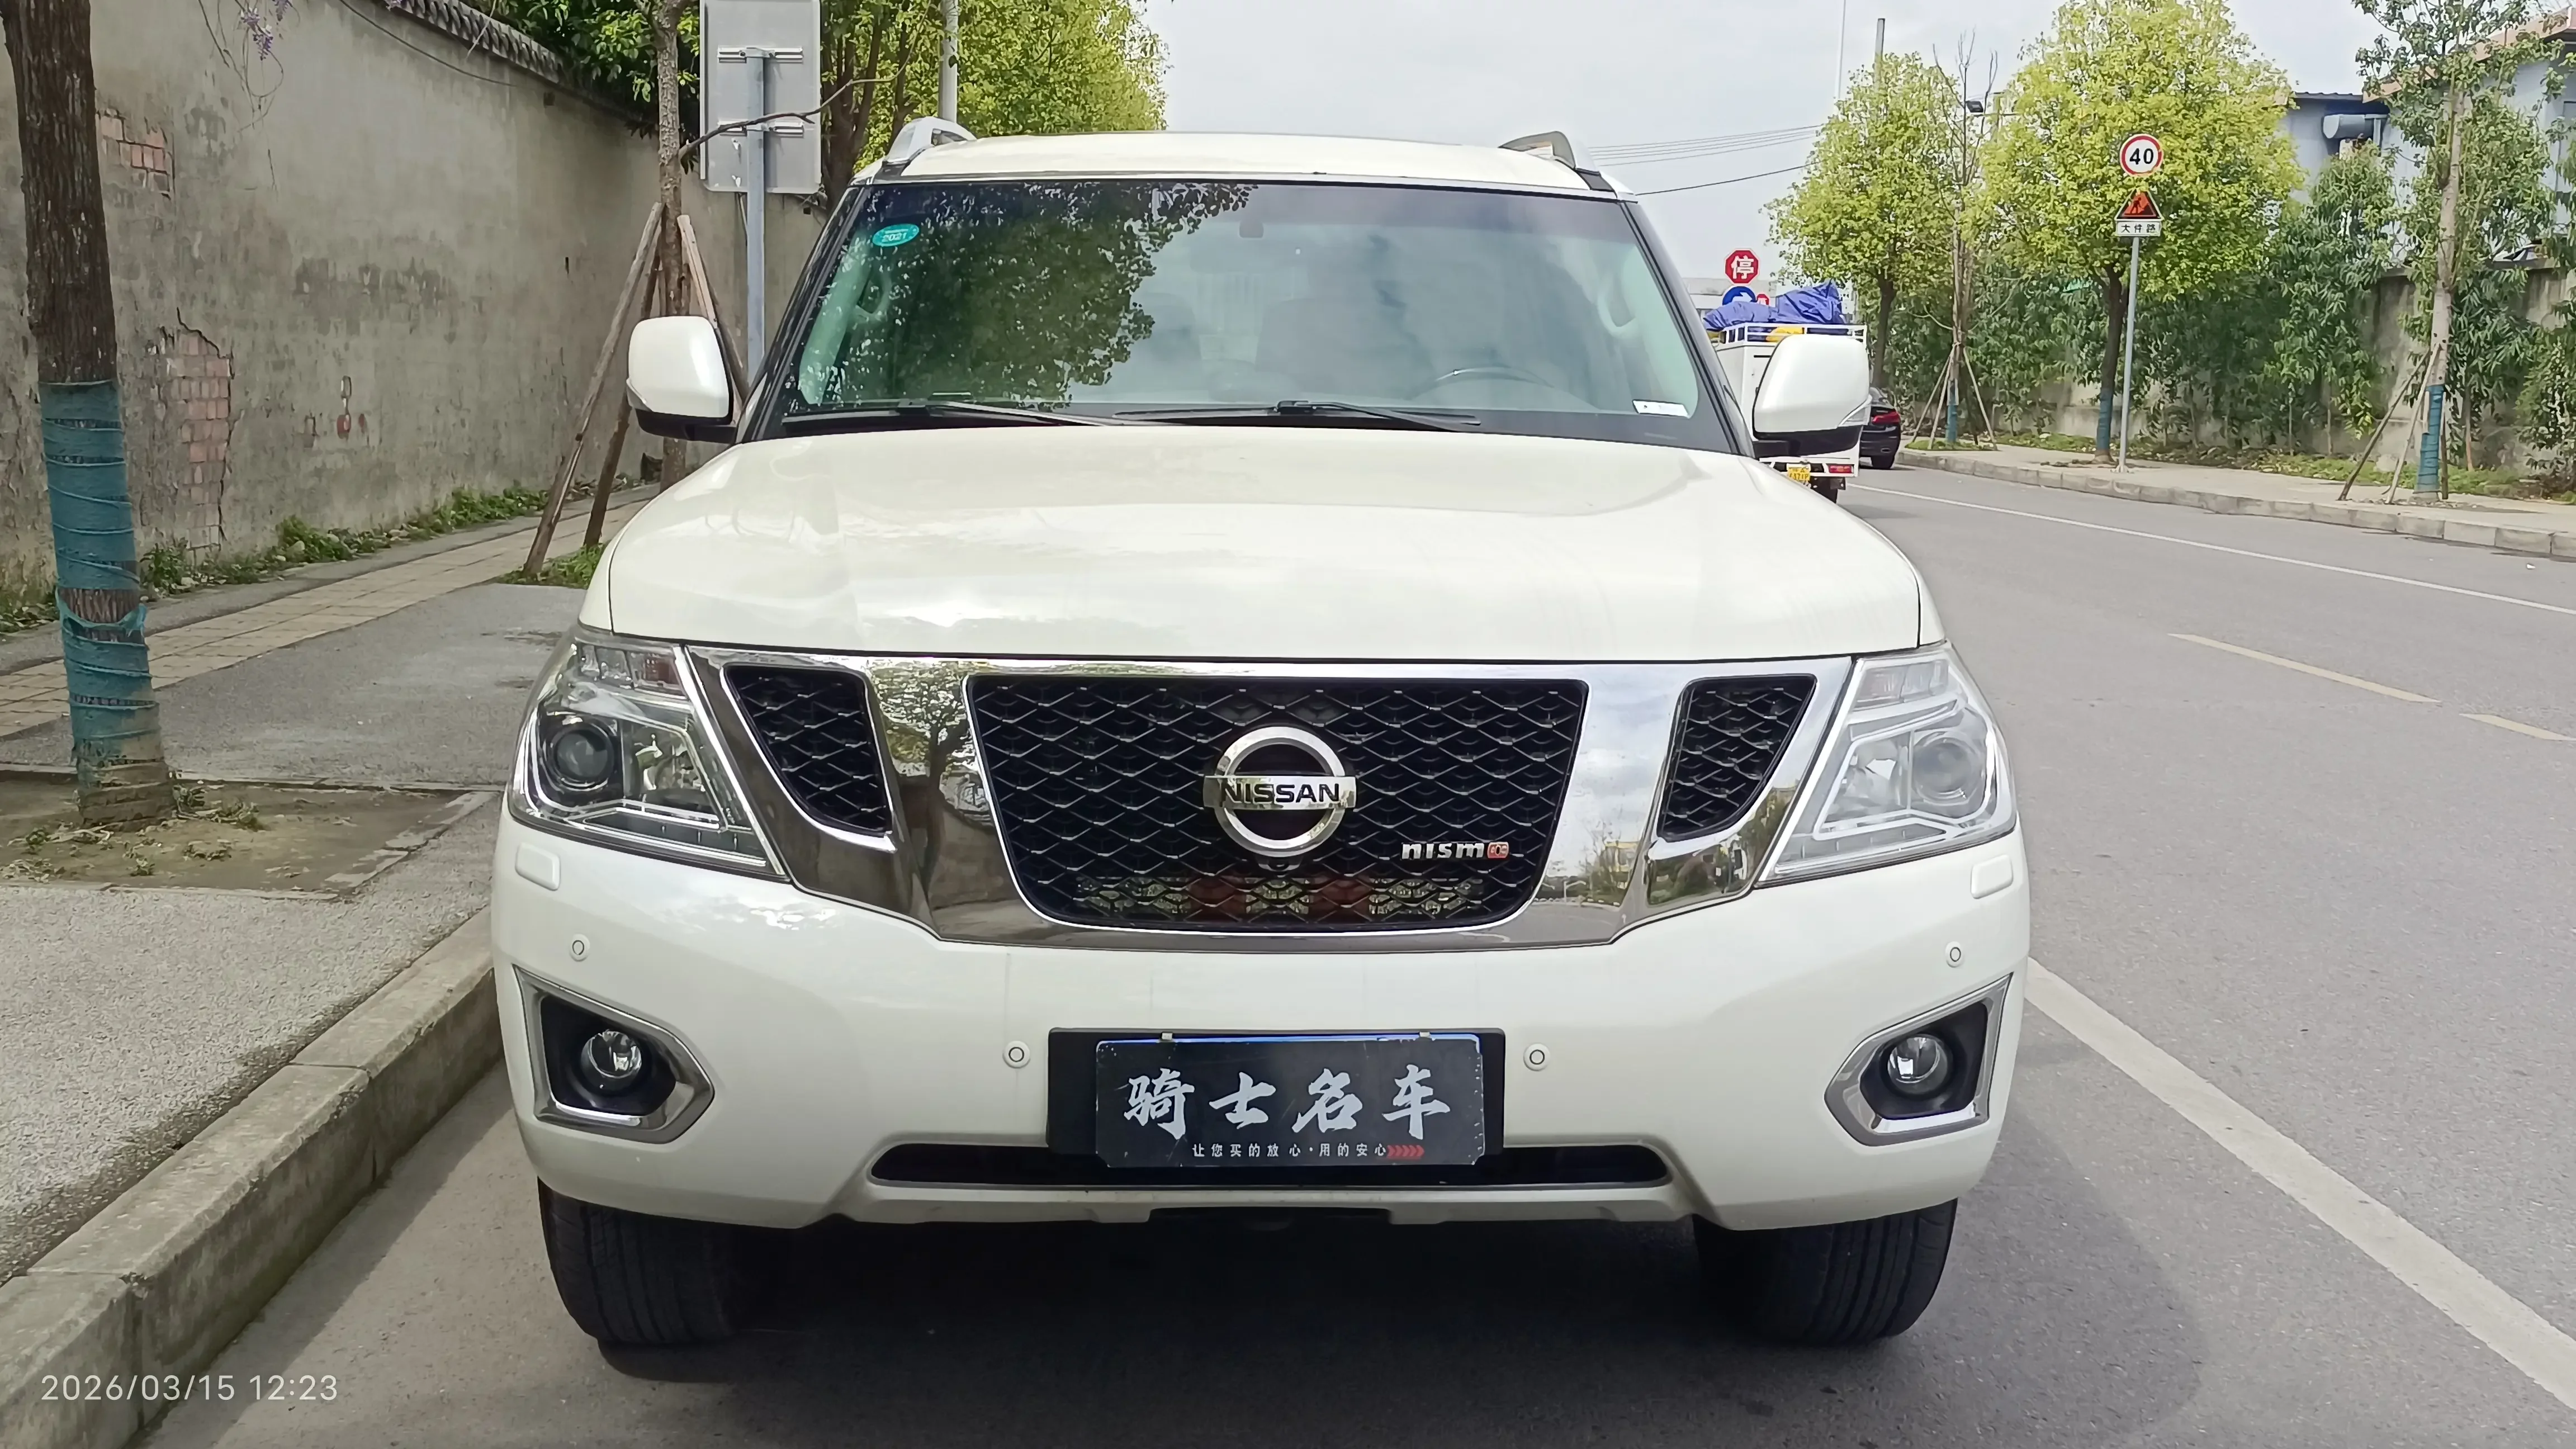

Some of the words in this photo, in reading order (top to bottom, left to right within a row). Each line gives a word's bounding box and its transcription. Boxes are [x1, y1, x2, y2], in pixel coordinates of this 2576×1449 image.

[2129, 148, 2154, 165] 40
[882, 232, 907, 242] 2021
[1731, 255, 1754, 280] 停
[1220, 783, 1339, 803] NISSAN
[1124, 1064, 1451, 1140] 骑士名车
